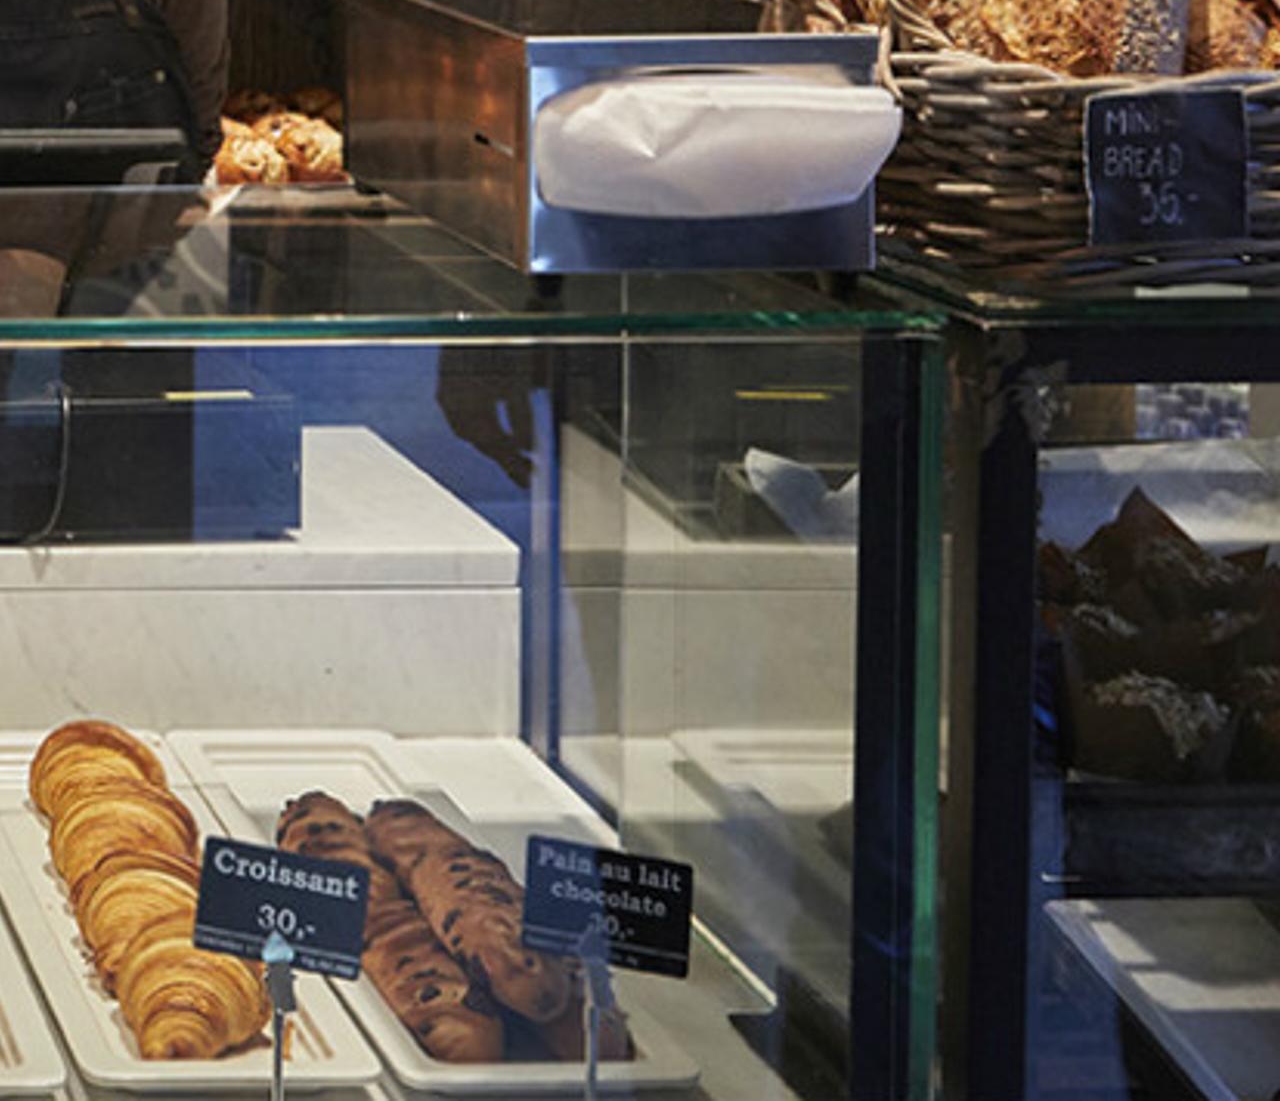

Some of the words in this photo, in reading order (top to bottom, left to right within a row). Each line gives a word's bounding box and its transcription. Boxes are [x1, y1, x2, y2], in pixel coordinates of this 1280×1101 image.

[1103, 141, 1184, 179] BREAD
[213, 849, 360, 900] Croissant
[538, 845, 593, 874] Pain
[600, 862, 631, 882] au
[640, 864, 682, 892] lait
[551, 878, 667, 917] chocolate
[257, 903, 317, 940] 30,-
